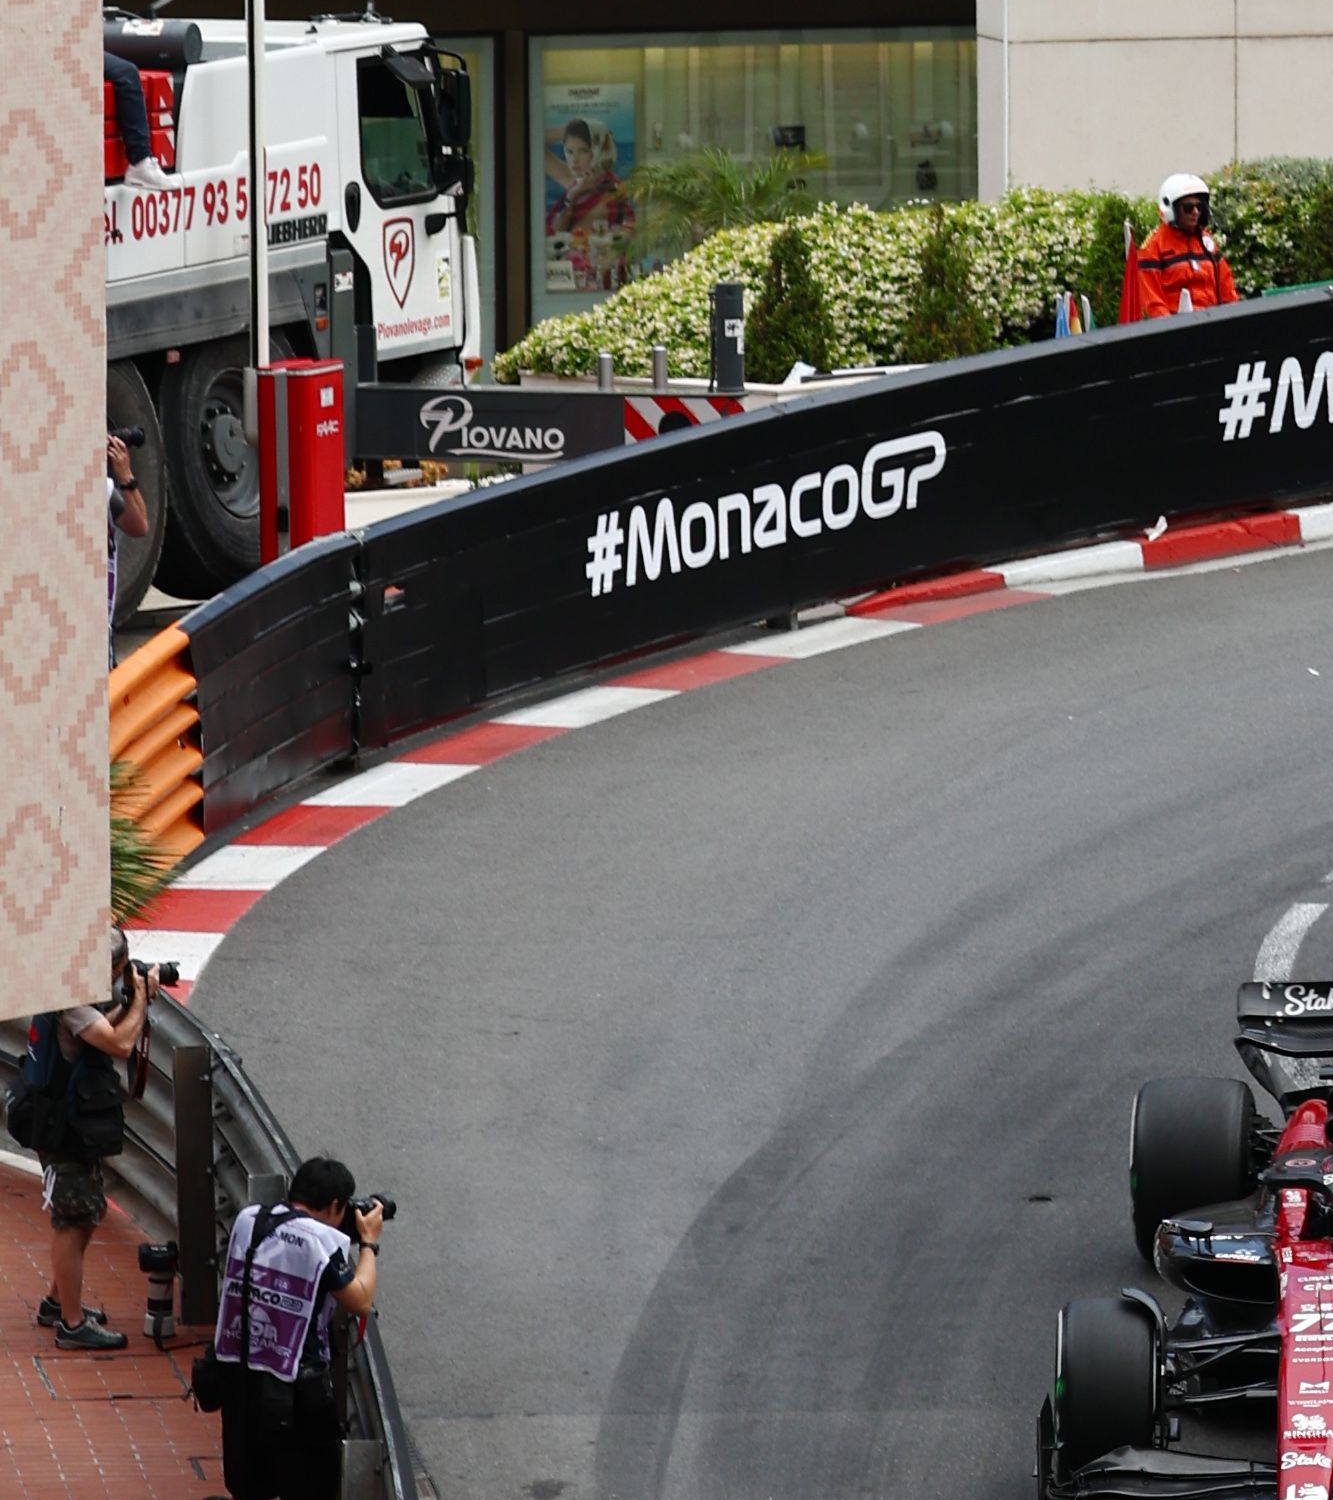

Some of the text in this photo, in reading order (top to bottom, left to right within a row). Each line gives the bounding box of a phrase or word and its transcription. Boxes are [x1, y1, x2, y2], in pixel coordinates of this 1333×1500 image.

[131, 186, 195, 240] 00377
[203, 180, 228, 226] 93
[268, 168, 291, 215] 72
[297, 162, 321, 209] 50
[585, 430, 947, 598] #MonacoGP
[1281, 1451, 1331, 1470] Stake
